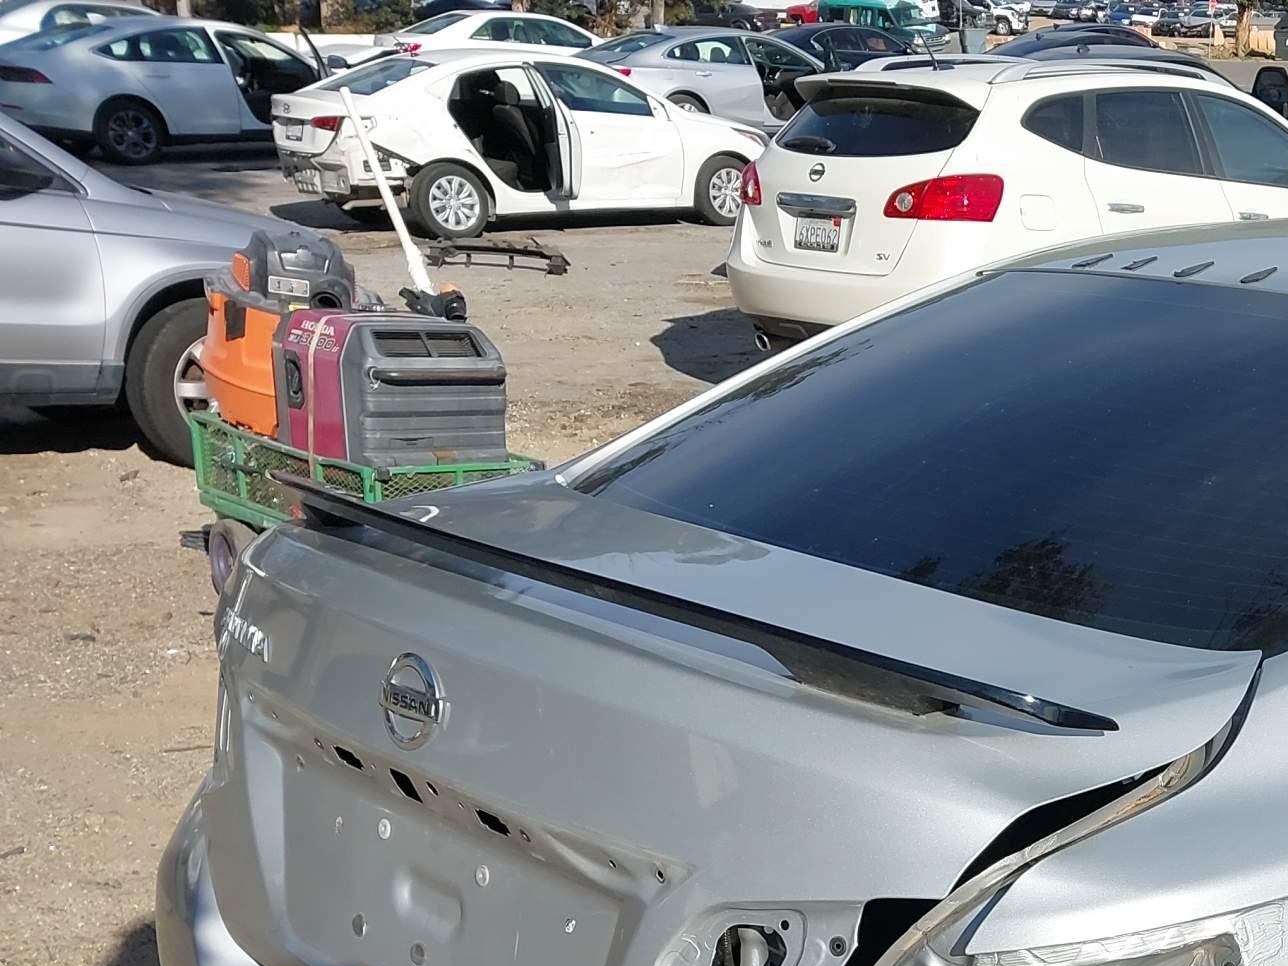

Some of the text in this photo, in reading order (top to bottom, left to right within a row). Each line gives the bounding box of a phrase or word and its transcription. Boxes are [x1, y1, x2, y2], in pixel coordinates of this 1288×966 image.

[876, 252, 891, 261] SV
[301, 320, 335, 336] HODA
[383, 687, 432, 717] NISSAN
